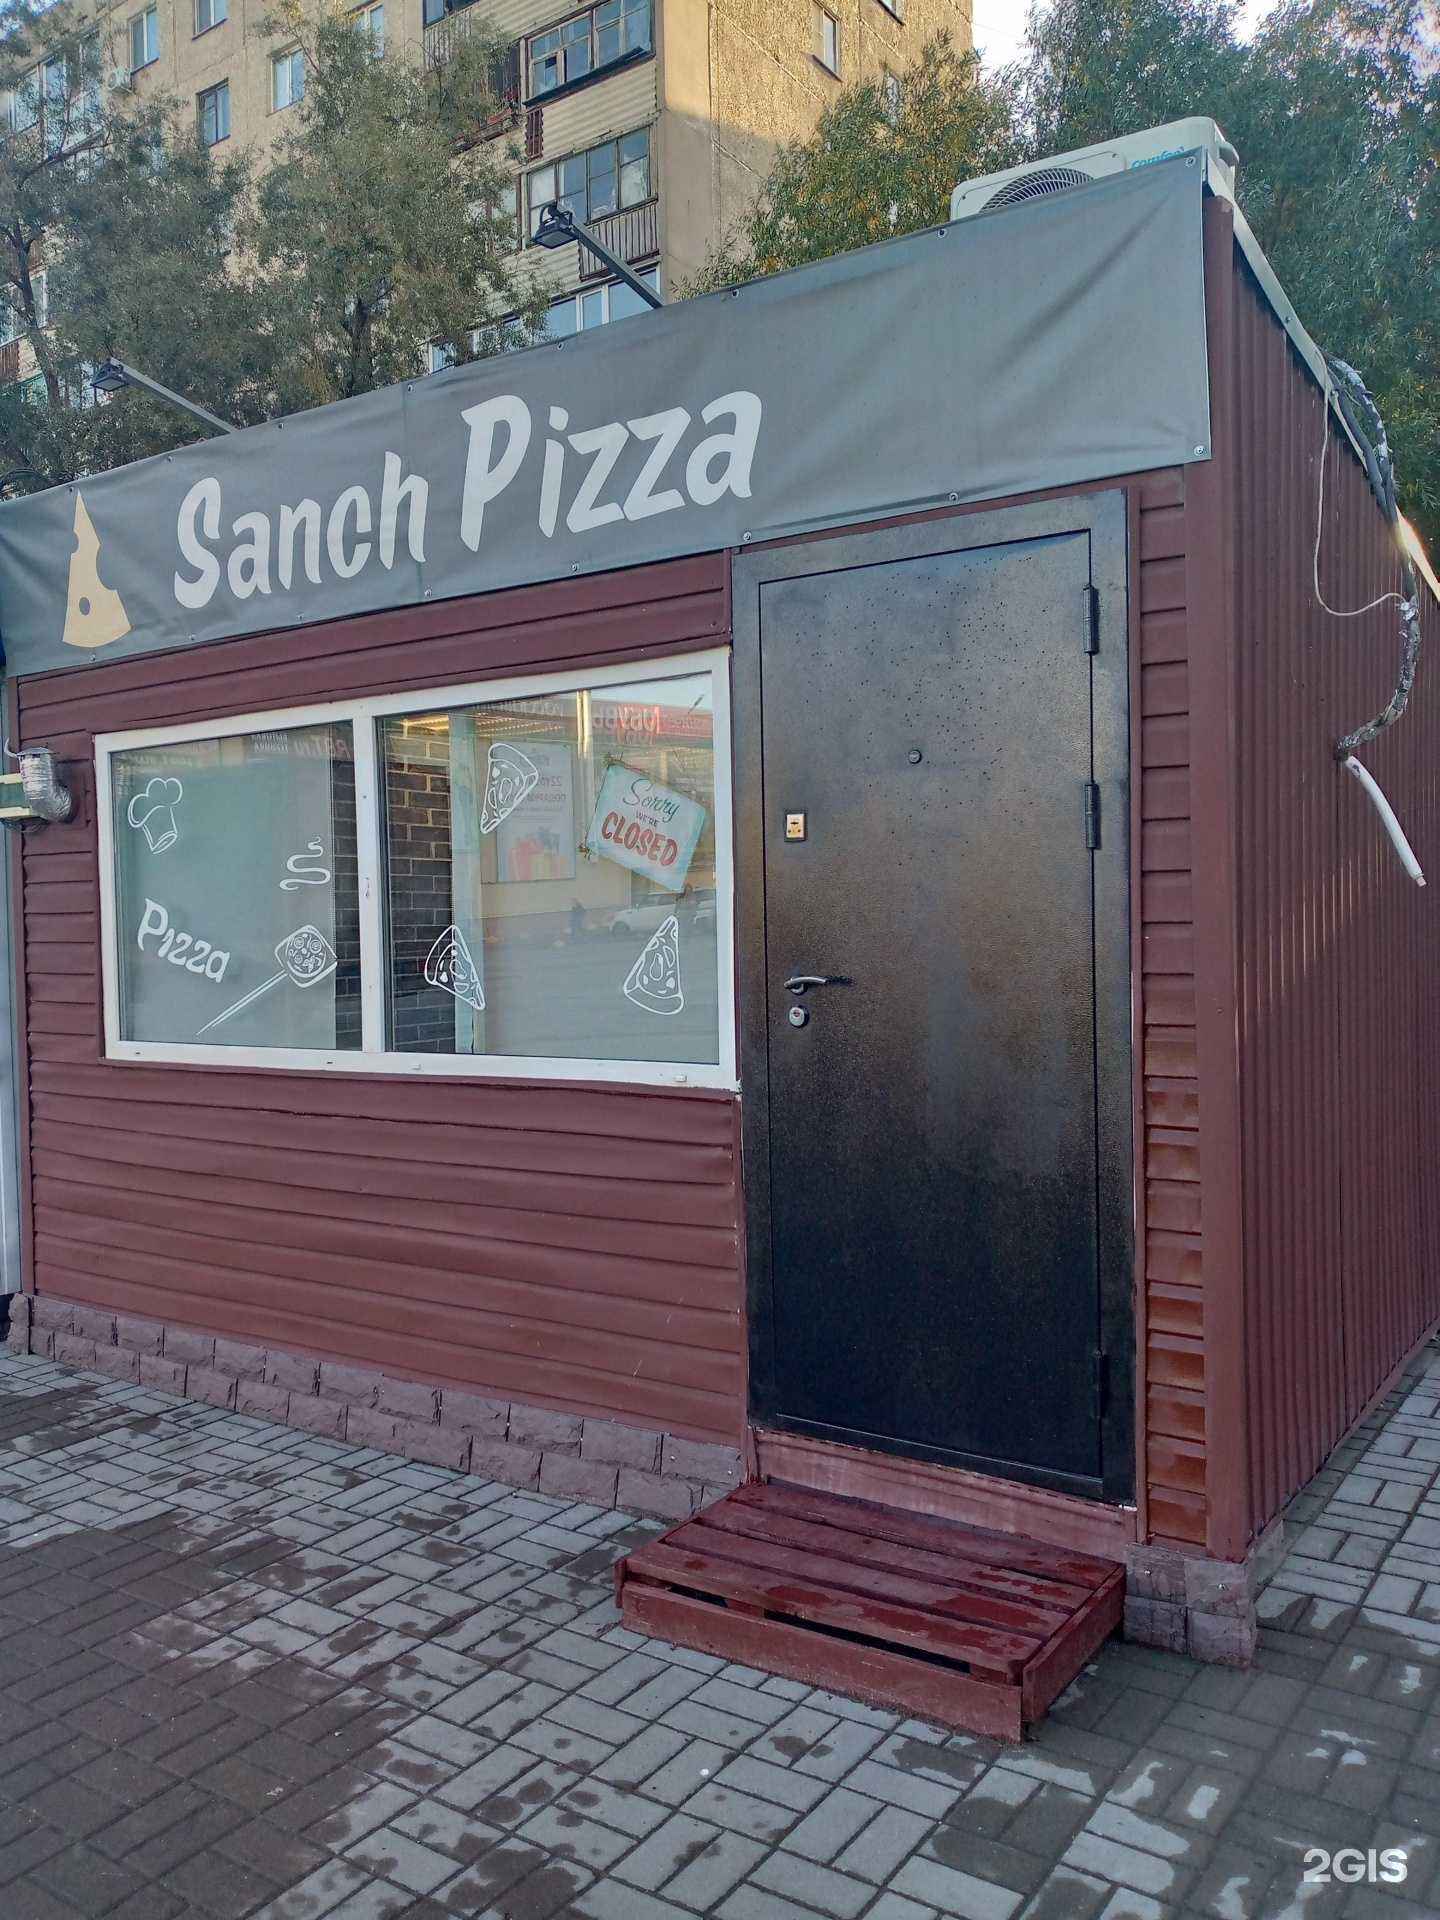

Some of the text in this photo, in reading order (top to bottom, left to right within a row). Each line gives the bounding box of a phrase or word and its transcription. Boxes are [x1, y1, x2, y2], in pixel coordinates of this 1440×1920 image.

[174, 390, 763, 608] Sanch Pizza
[622, 779, 680, 823] Sorry
[602, 811, 677, 866] CLOSED
[137, 898, 230, 983] Pizza
